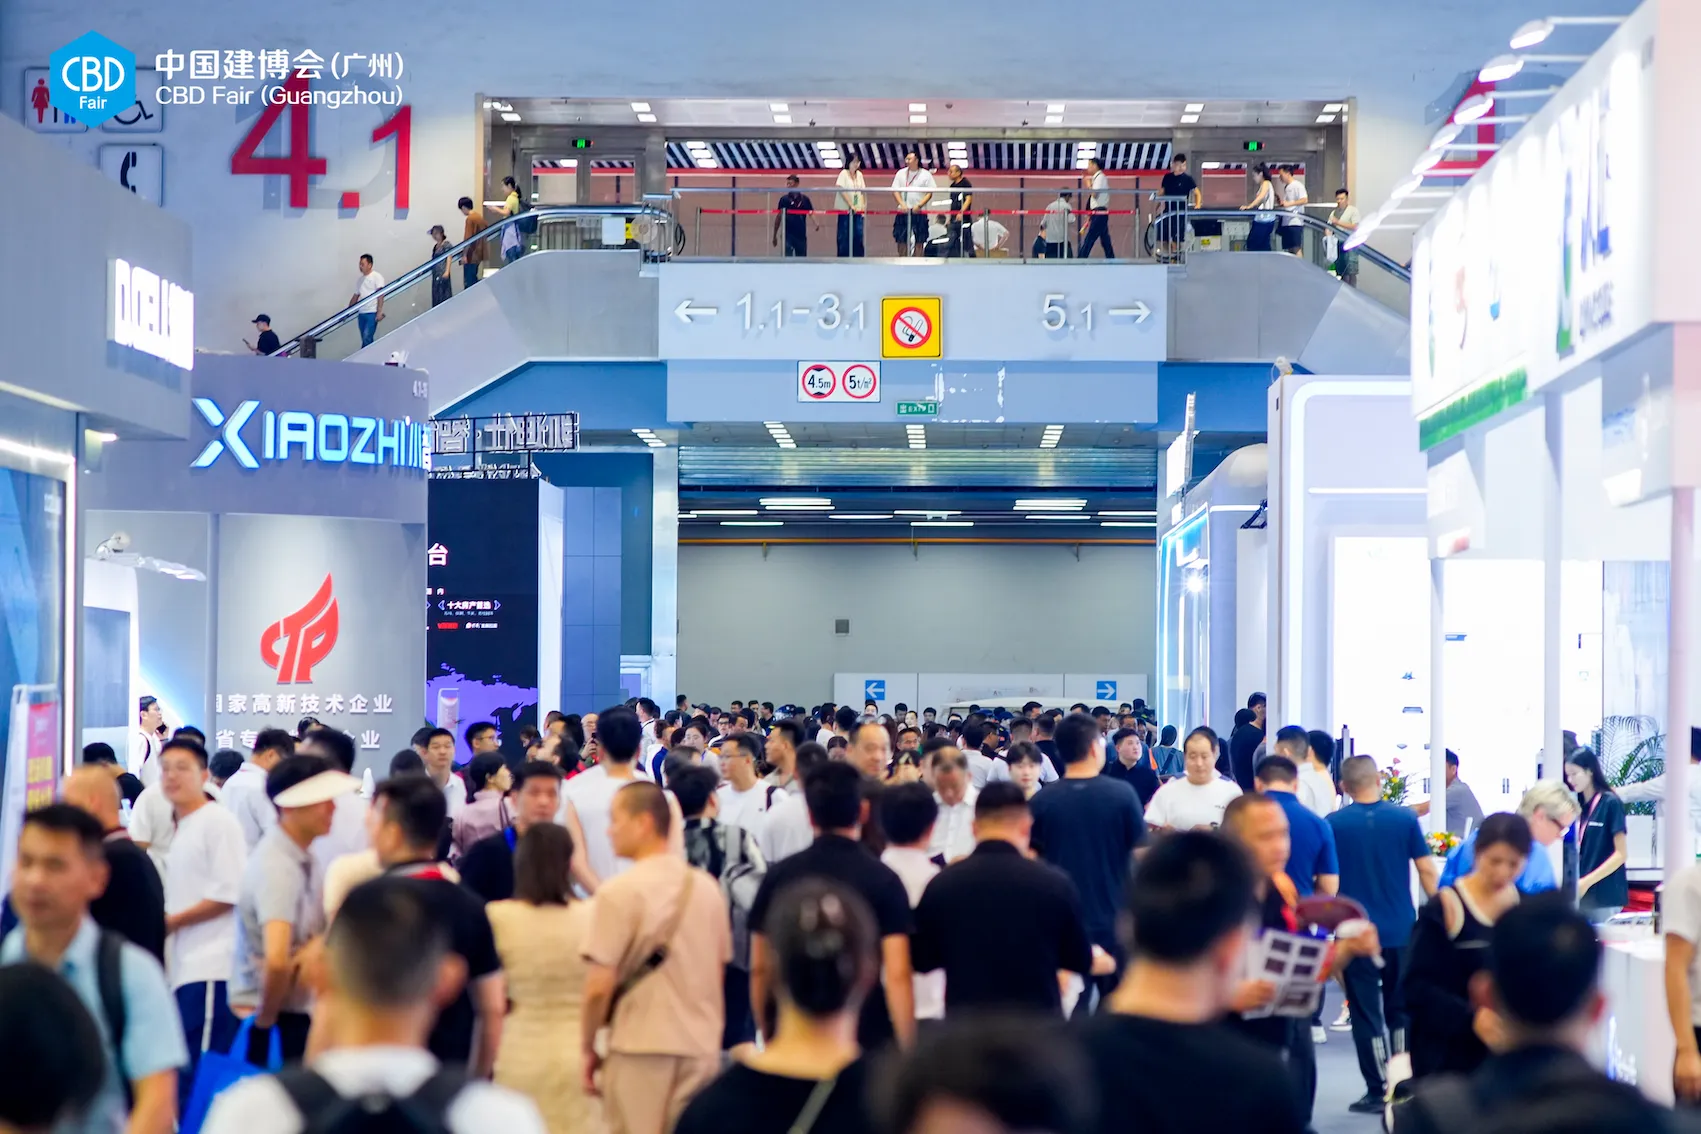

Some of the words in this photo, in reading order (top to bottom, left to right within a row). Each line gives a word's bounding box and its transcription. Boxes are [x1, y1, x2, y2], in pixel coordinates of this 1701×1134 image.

[231, 67, 411, 208] 4.1
[737, 293, 864, 330] 1.1-3.1
[1042, 294, 1092, 331] 5.1
[807, 374, 831, 389] 4.5m
[428, 543, 448, 566] 台
